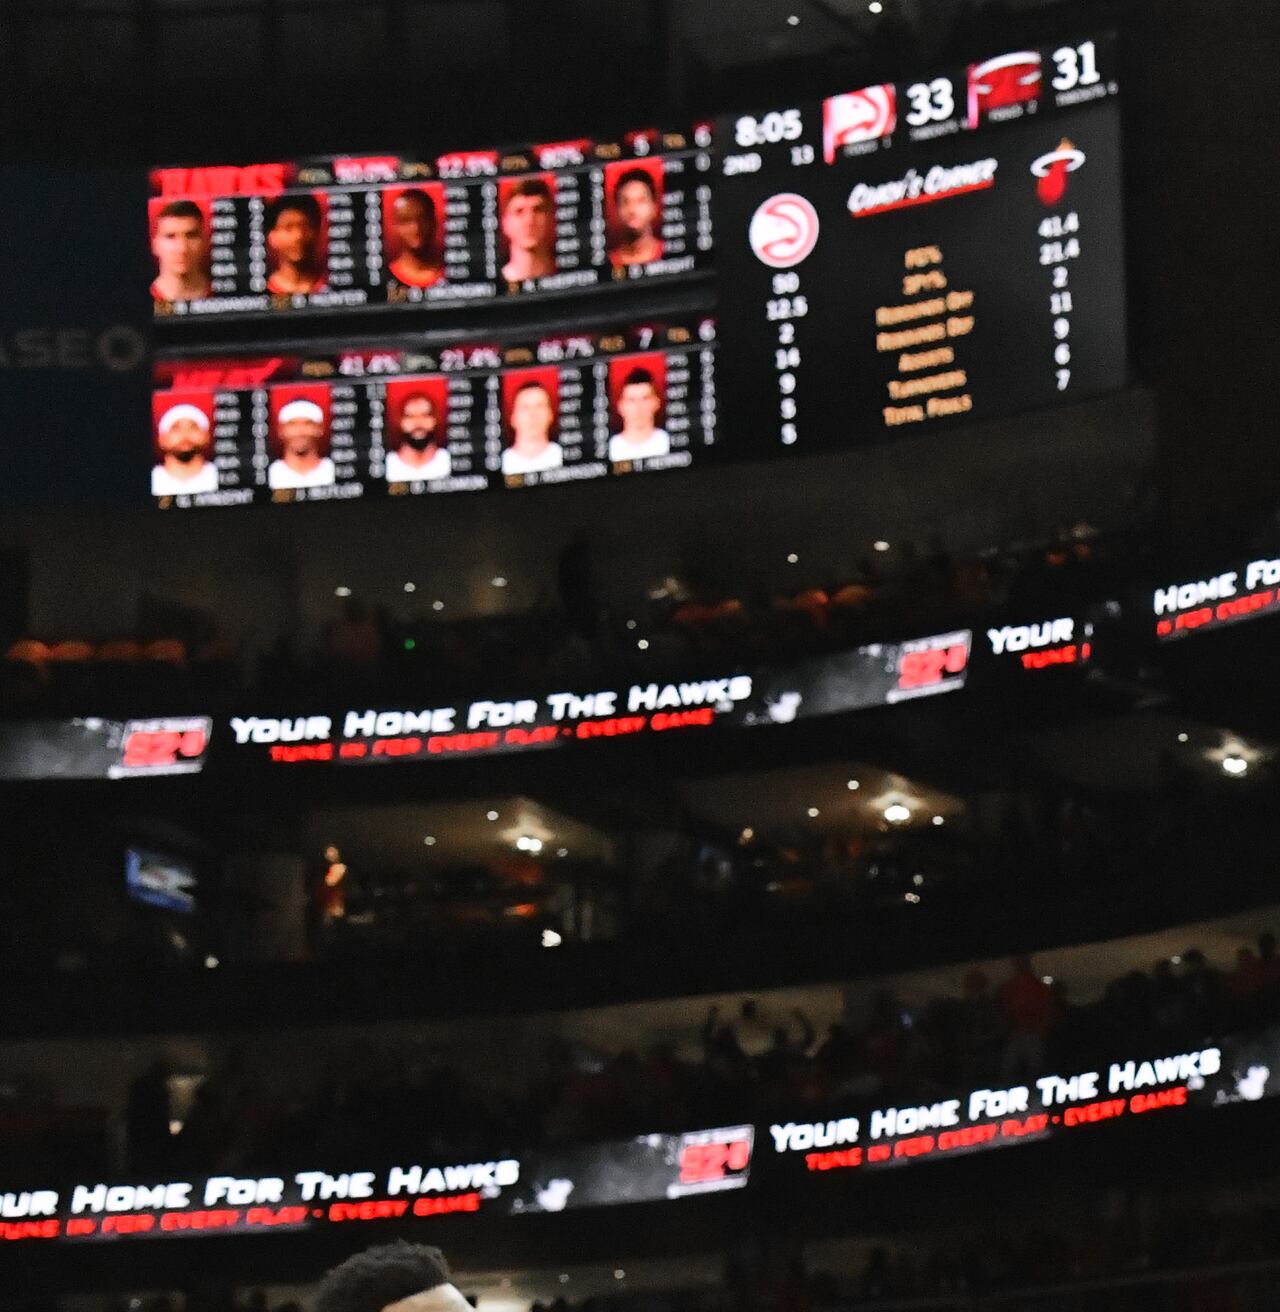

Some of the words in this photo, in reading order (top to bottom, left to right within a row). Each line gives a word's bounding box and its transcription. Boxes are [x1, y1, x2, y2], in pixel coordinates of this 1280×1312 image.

[1052, 41, 1101, 91] 31
[906, 77, 954, 125] 33
[735, 109, 803, 147] 8:05
[722, 152, 763, 175] 2ND
[1037, 212, 1080, 239] 41.4
[1050, 291, 1073, 315] 11
[1054, 369, 1071, 391] 7
[1153, 571, 1238, 616] HOME
[987, 617, 1074, 655] YOUR
[230, 715, 332, 744] YOUR
[343, 707, 457, 738] HOME
[466, 699, 538, 730] FOR
[546, 691, 618, 721] THE
[628, 675, 753, 712] HAWKS
[769, 1117, 860, 1153] YOUR
[870, 1099, 961, 1140] HOME
[968, 1086, 1030, 1122] FOR
[1035, 1071, 1100, 1107] THE
[1109, 1048, 1220, 1090] HAWKS
[0, 1190, 59, 1218] UR
[70, 1182, 193, 1214] HOME
[203, 1176, 285, 1207] FOR
[295, 1171, 376, 1201] THE
[388, 1160, 519, 1195] HAWKS
